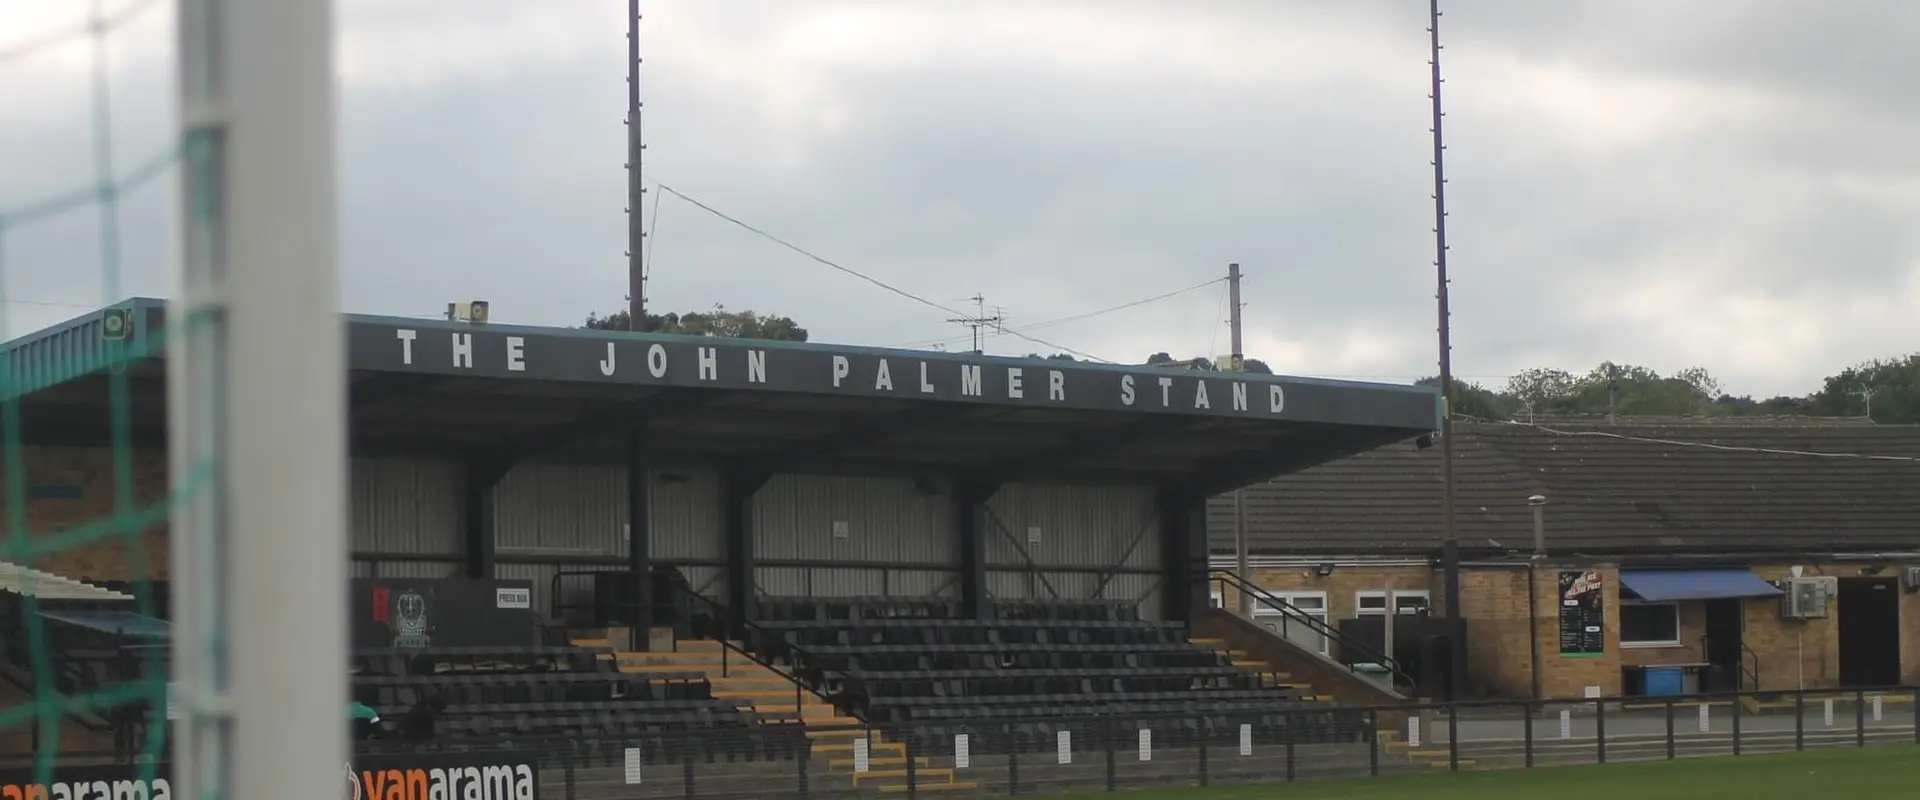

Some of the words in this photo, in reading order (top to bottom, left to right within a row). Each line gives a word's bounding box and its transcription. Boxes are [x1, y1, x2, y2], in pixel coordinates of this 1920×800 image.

[397, 328, 526, 371] THE
[599, 342, 767, 383] JOHN
[832, 355, 1065, 401] PALMER
[1121, 374, 1285, 414] STAND
[498, 592, 515, 603] PRESS
[516, 592, 527, 603] BOX
[363, 764, 534, 800] vanarama
